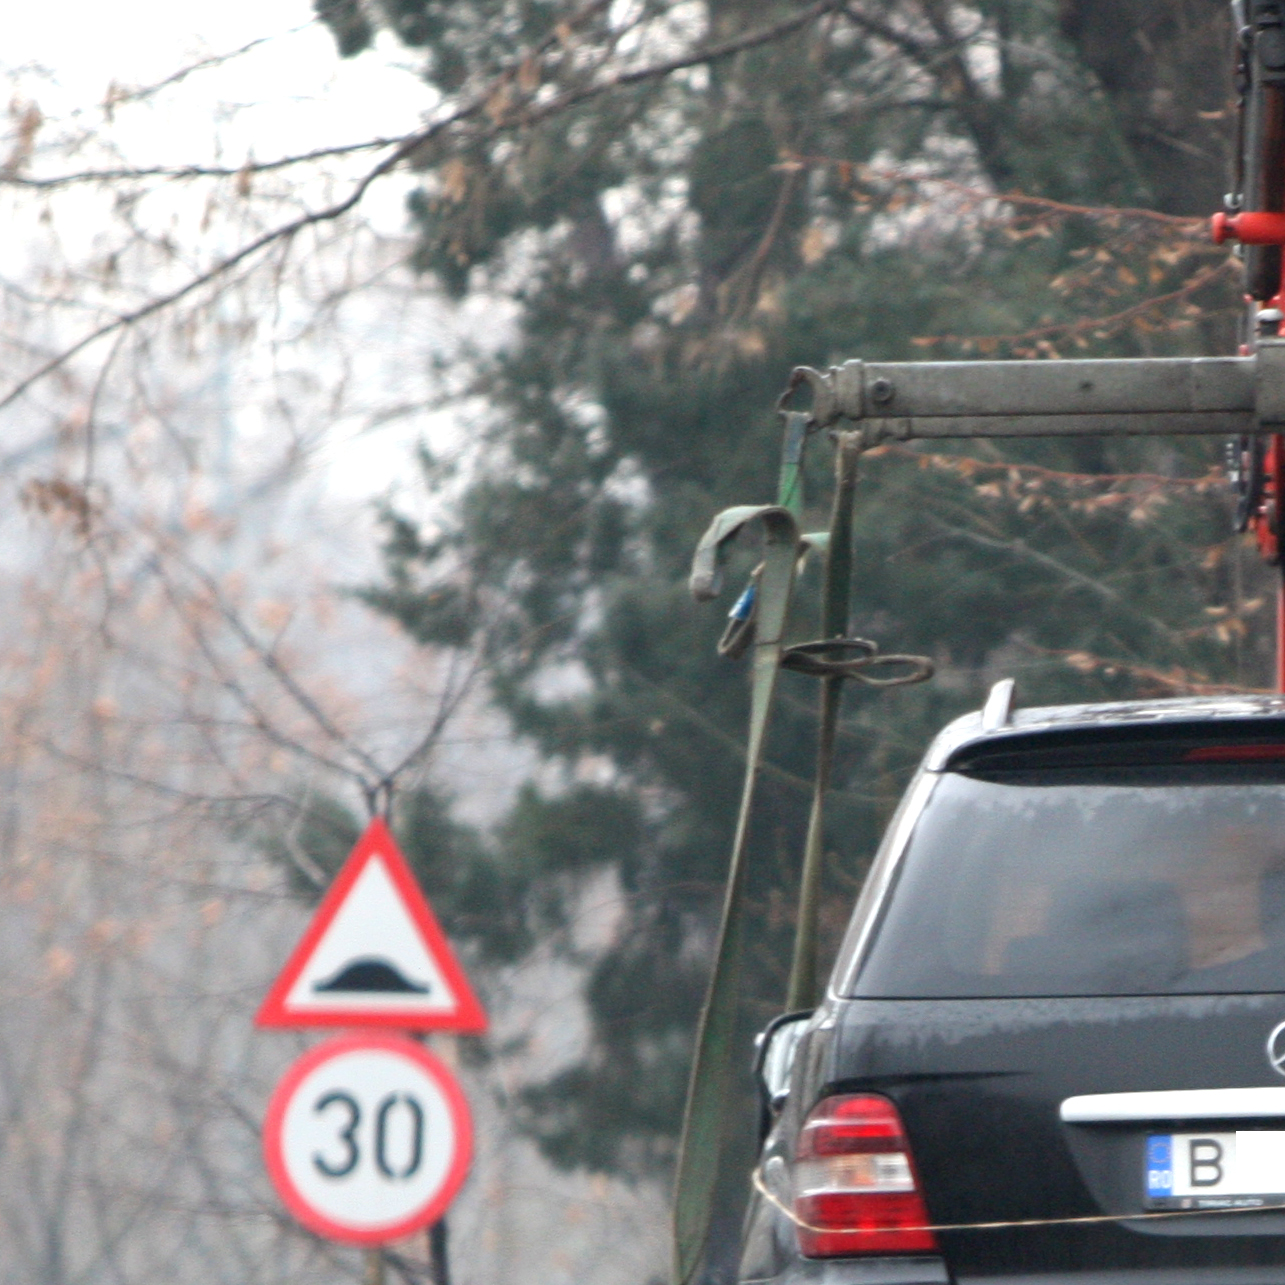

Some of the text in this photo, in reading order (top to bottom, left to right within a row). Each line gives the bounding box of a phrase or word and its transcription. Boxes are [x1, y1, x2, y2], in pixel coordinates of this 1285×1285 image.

[312, 1089, 424, 1178] 30
[1149, 1169, 1172, 1189] RO
[1189, 1138, 1224, 1188] B
